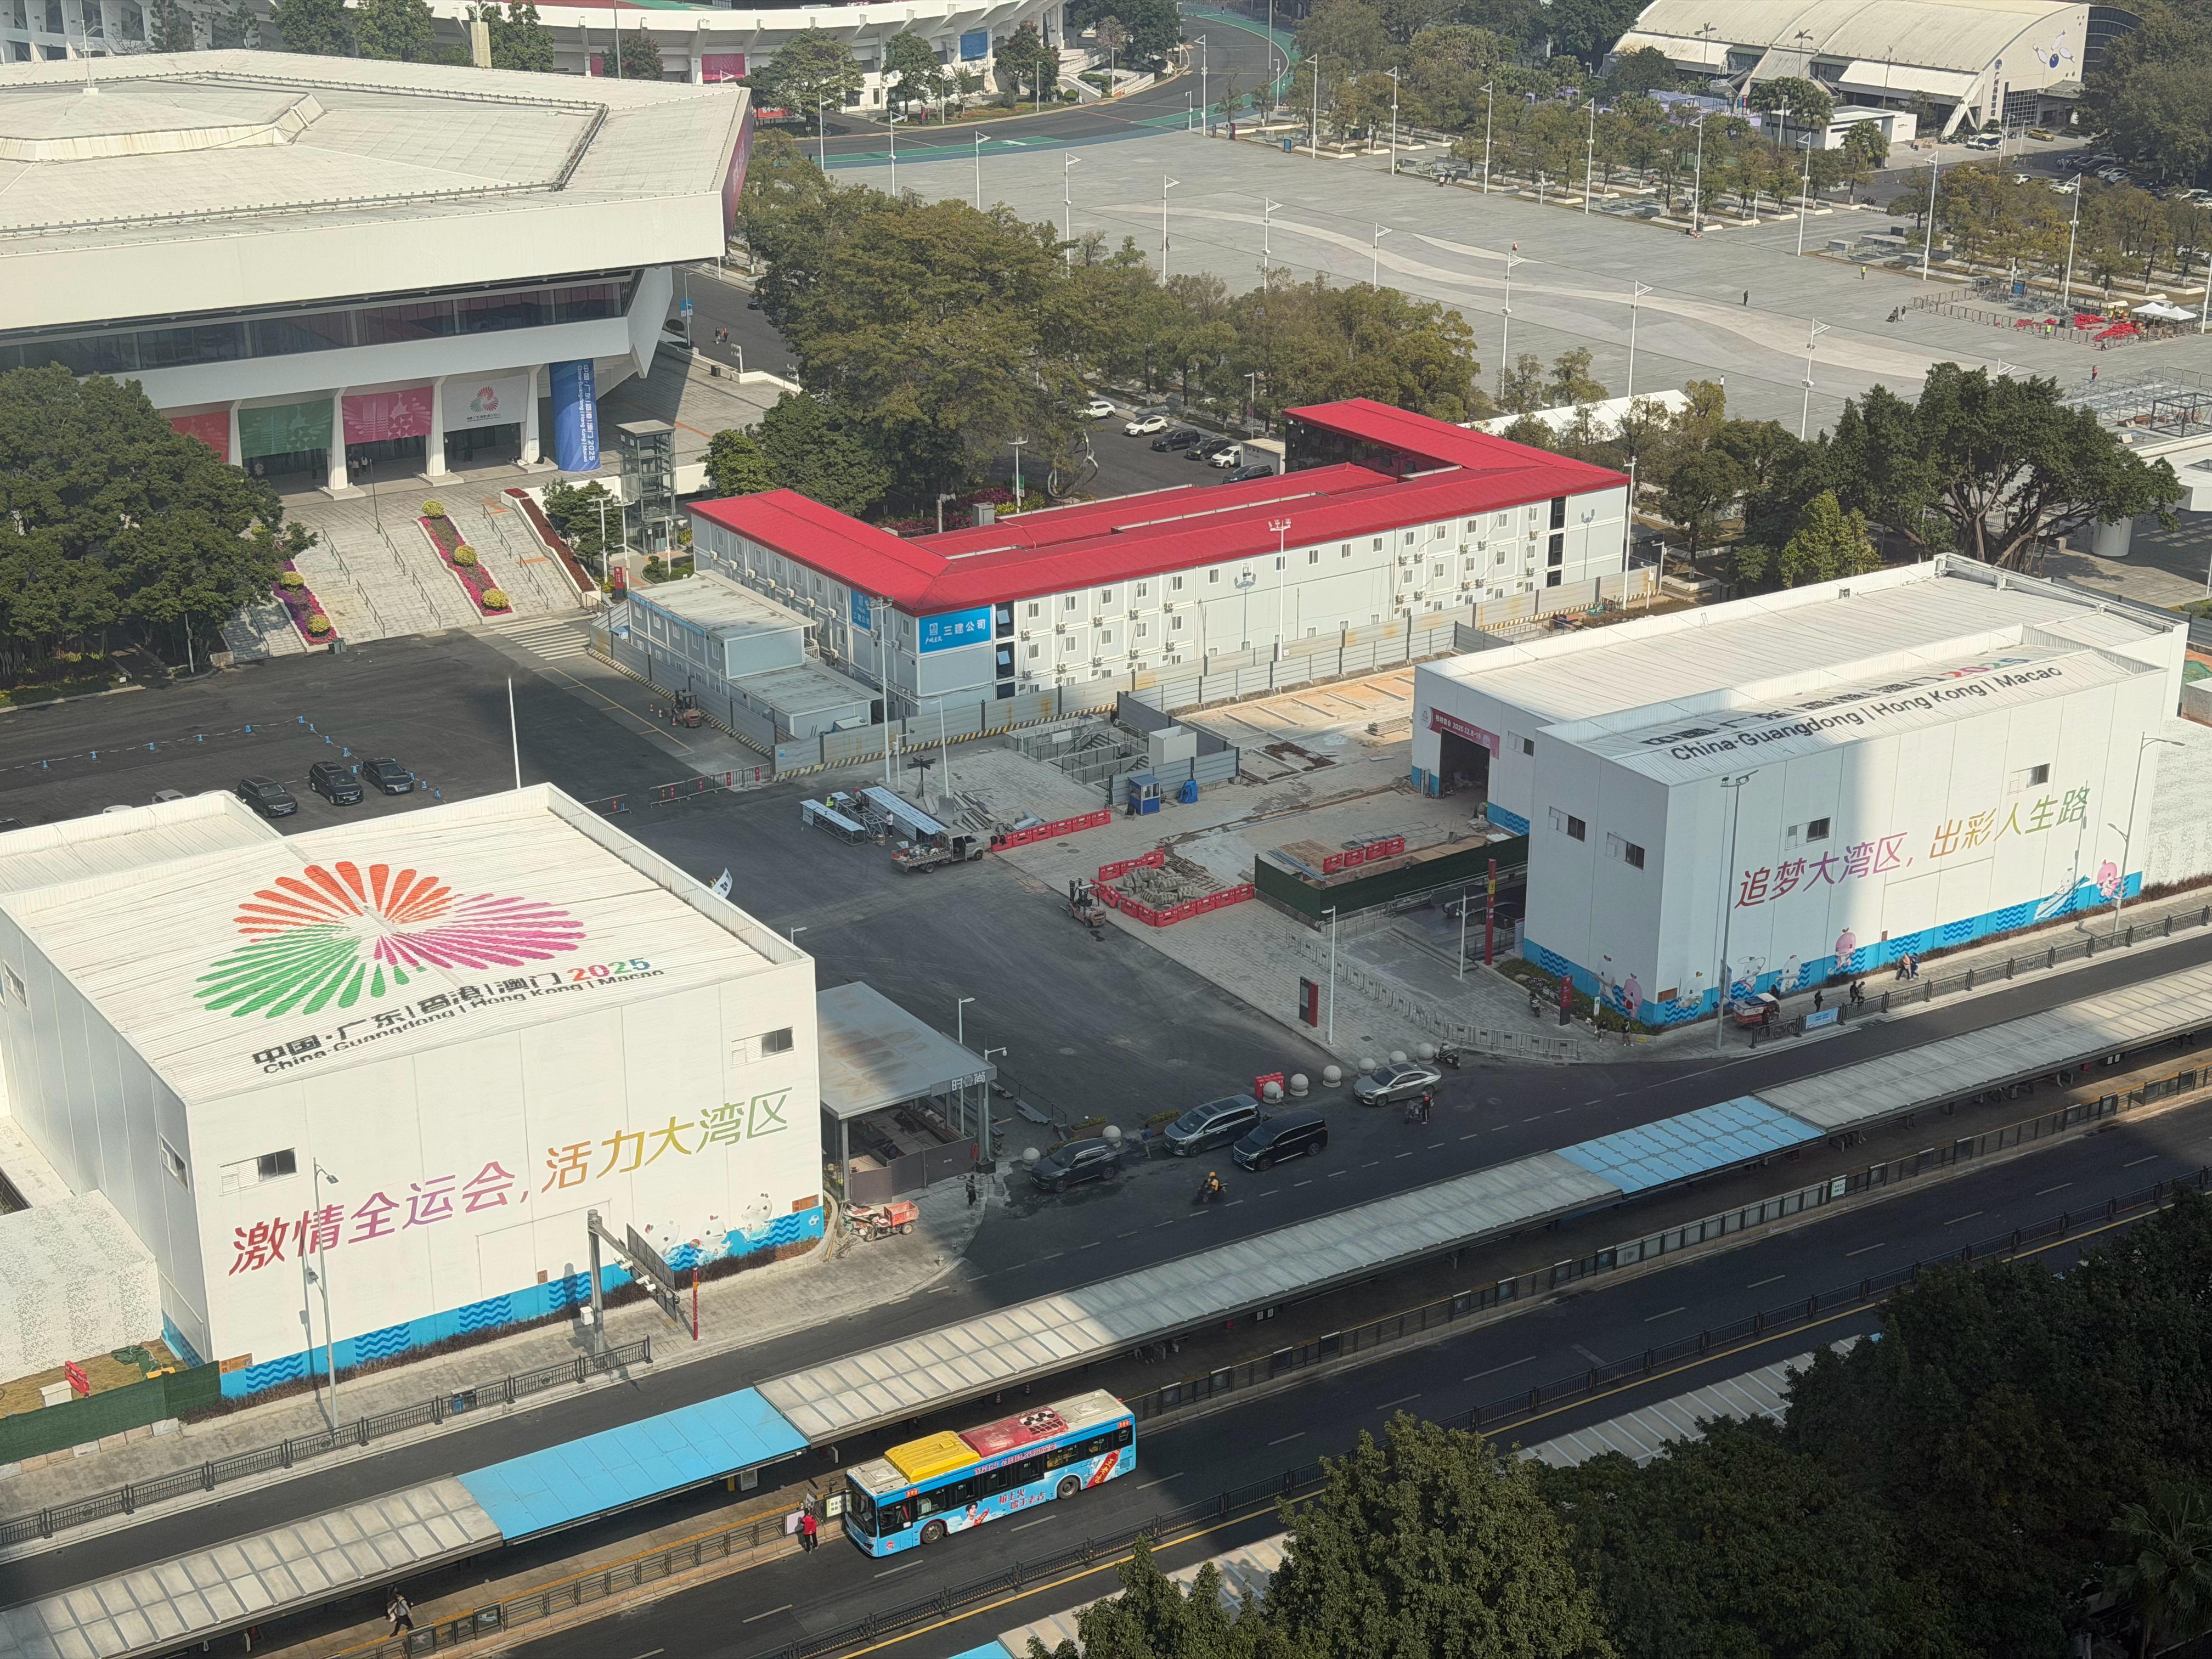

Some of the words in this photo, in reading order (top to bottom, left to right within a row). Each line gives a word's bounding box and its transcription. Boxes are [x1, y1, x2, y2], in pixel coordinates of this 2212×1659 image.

[944, 619, 985, 636] 三建公司
[1871, 695, 1933, 716] Hong
[1929, 684, 1988, 703] Kong
[1993, 666, 2063, 688] Macao
[567, 957, 650, 981] 2025
[470, 993, 526, 1008] Hong
[531, 983, 583, 996] Kong
